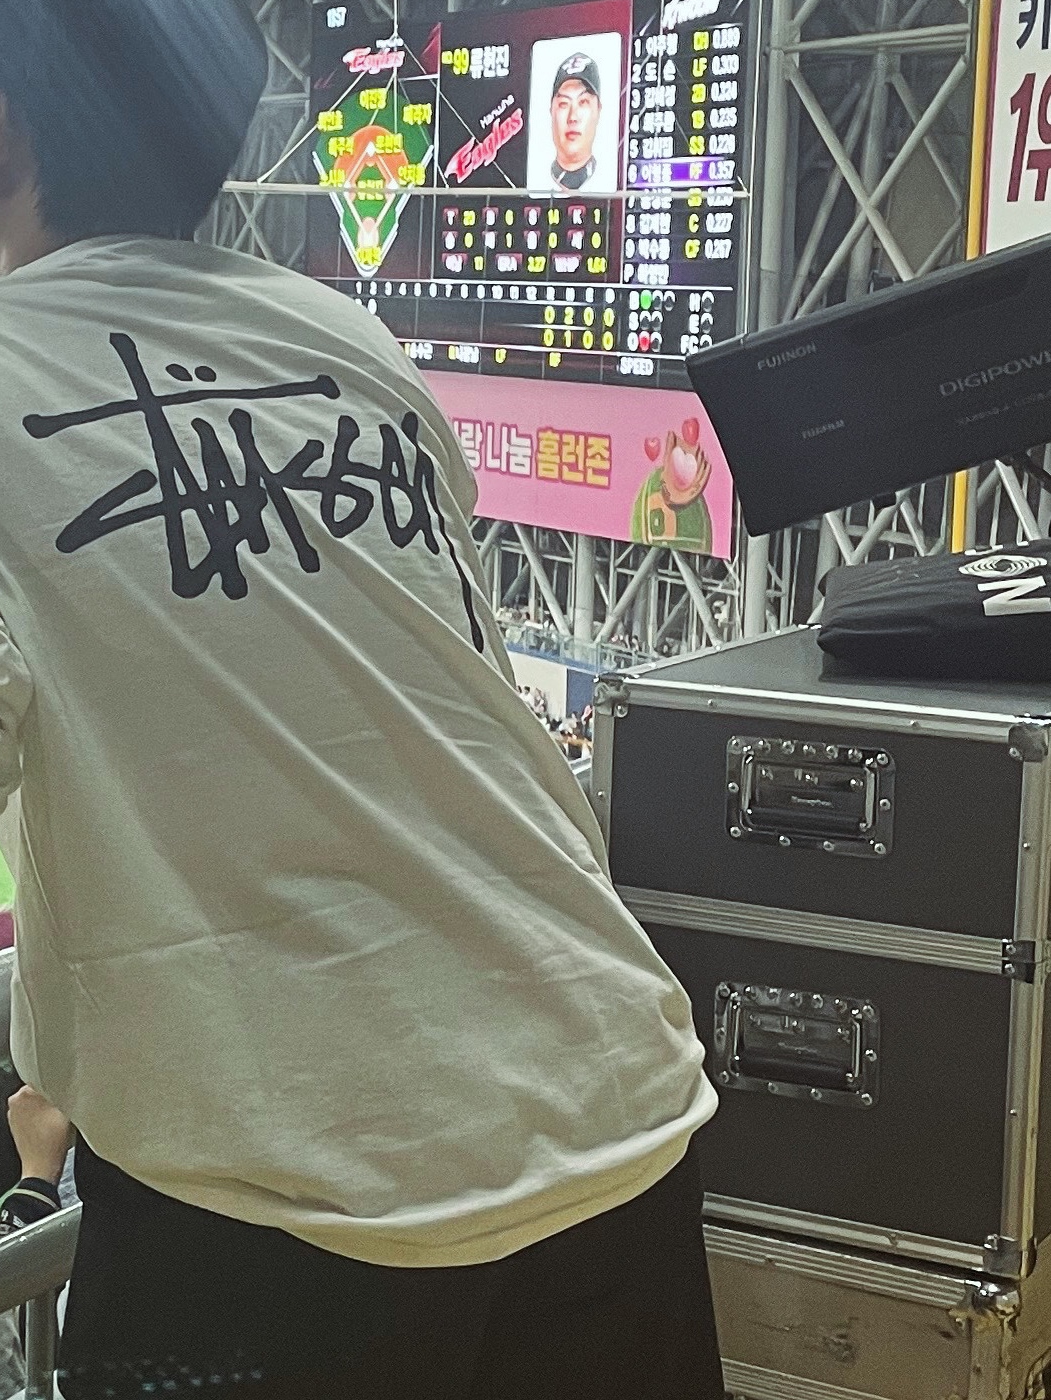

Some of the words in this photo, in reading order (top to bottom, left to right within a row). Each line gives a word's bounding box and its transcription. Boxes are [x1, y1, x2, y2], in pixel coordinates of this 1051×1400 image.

[634, 39, 641, 57] 1
[453, 47, 469, 75] 99
[470, 44, 509, 79] 류현진
[632, 63, 641, 83] 2
[693, 57, 707, 77] LF
[631, 89, 640, 108] 3
[630, 114, 639, 133] 4
[444, 108, 524, 184] Eagles
[630, 139, 639, 158] 5
[446, 209, 455, 225] T
[572, 209, 583, 225] K
[594, 208, 601, 225] 1
[689, 213, 699, 233] C
[464, 232, 473, 248] 0
[505, 232, 513, 248] 1
[549, 232, 558, 249] 0
[591, 231, 602, 249] 0
[624, 263, 634, 282] P
[356, 281, 362, 295] 1
[369, 281, 377, 296] 2
[399, 282, 407, 296] 4
[445, 284, 452, 297] 7
[545, 306, 556, 324] 0
[564, 306, 574, 325] 2
[583, 306, 594, 326] 0
[604, 307, 615, 327] 0
[543, 329, 555, 346] 0
[564, 330, 572, 348] 1
[583, 330, 594, 350] 0
[603, 331, 614, 350] 0
[620, 356, 654, 375] SPEED
[757, 342, 817, 371] FUJINON
[536, 427, 611, 489] 홈런존
